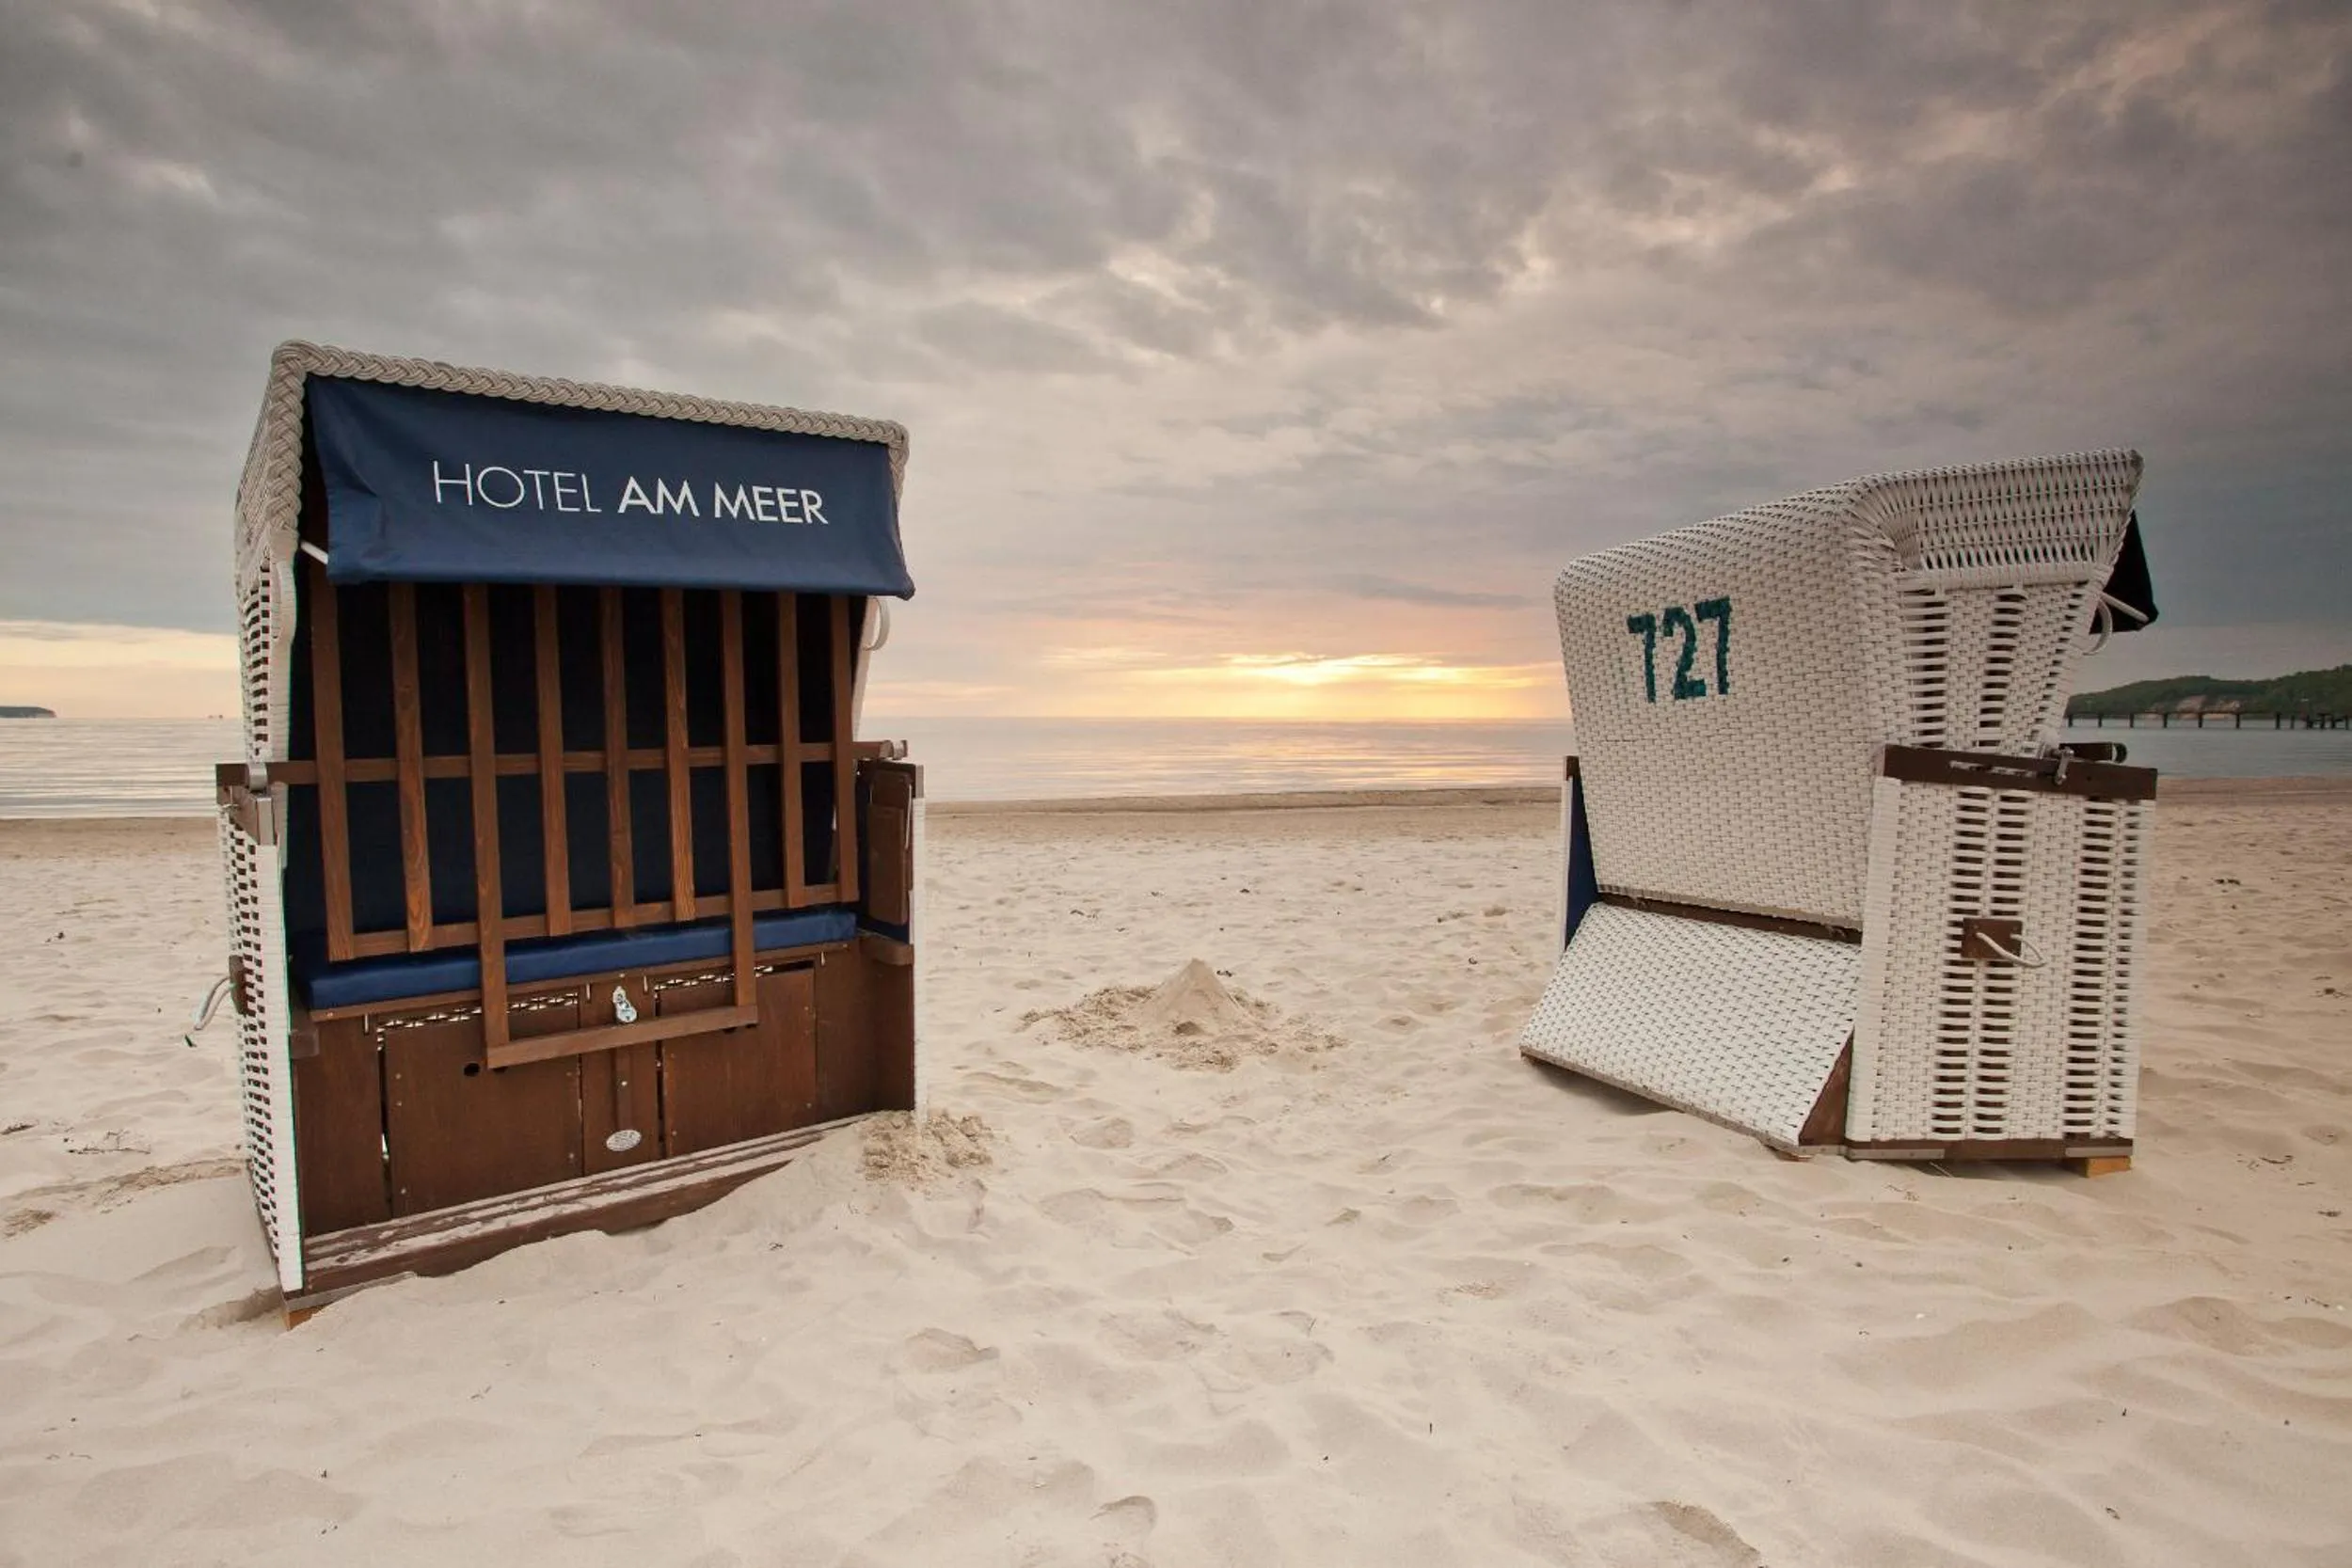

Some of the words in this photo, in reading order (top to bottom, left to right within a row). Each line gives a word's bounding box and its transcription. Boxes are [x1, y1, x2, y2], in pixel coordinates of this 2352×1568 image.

[433, 460, 602, 514] HOTEL
[617, 476, 700, 517] AM
[714, 482, 829, 525] MEER
[1627, 595, 1733, 704] 727
